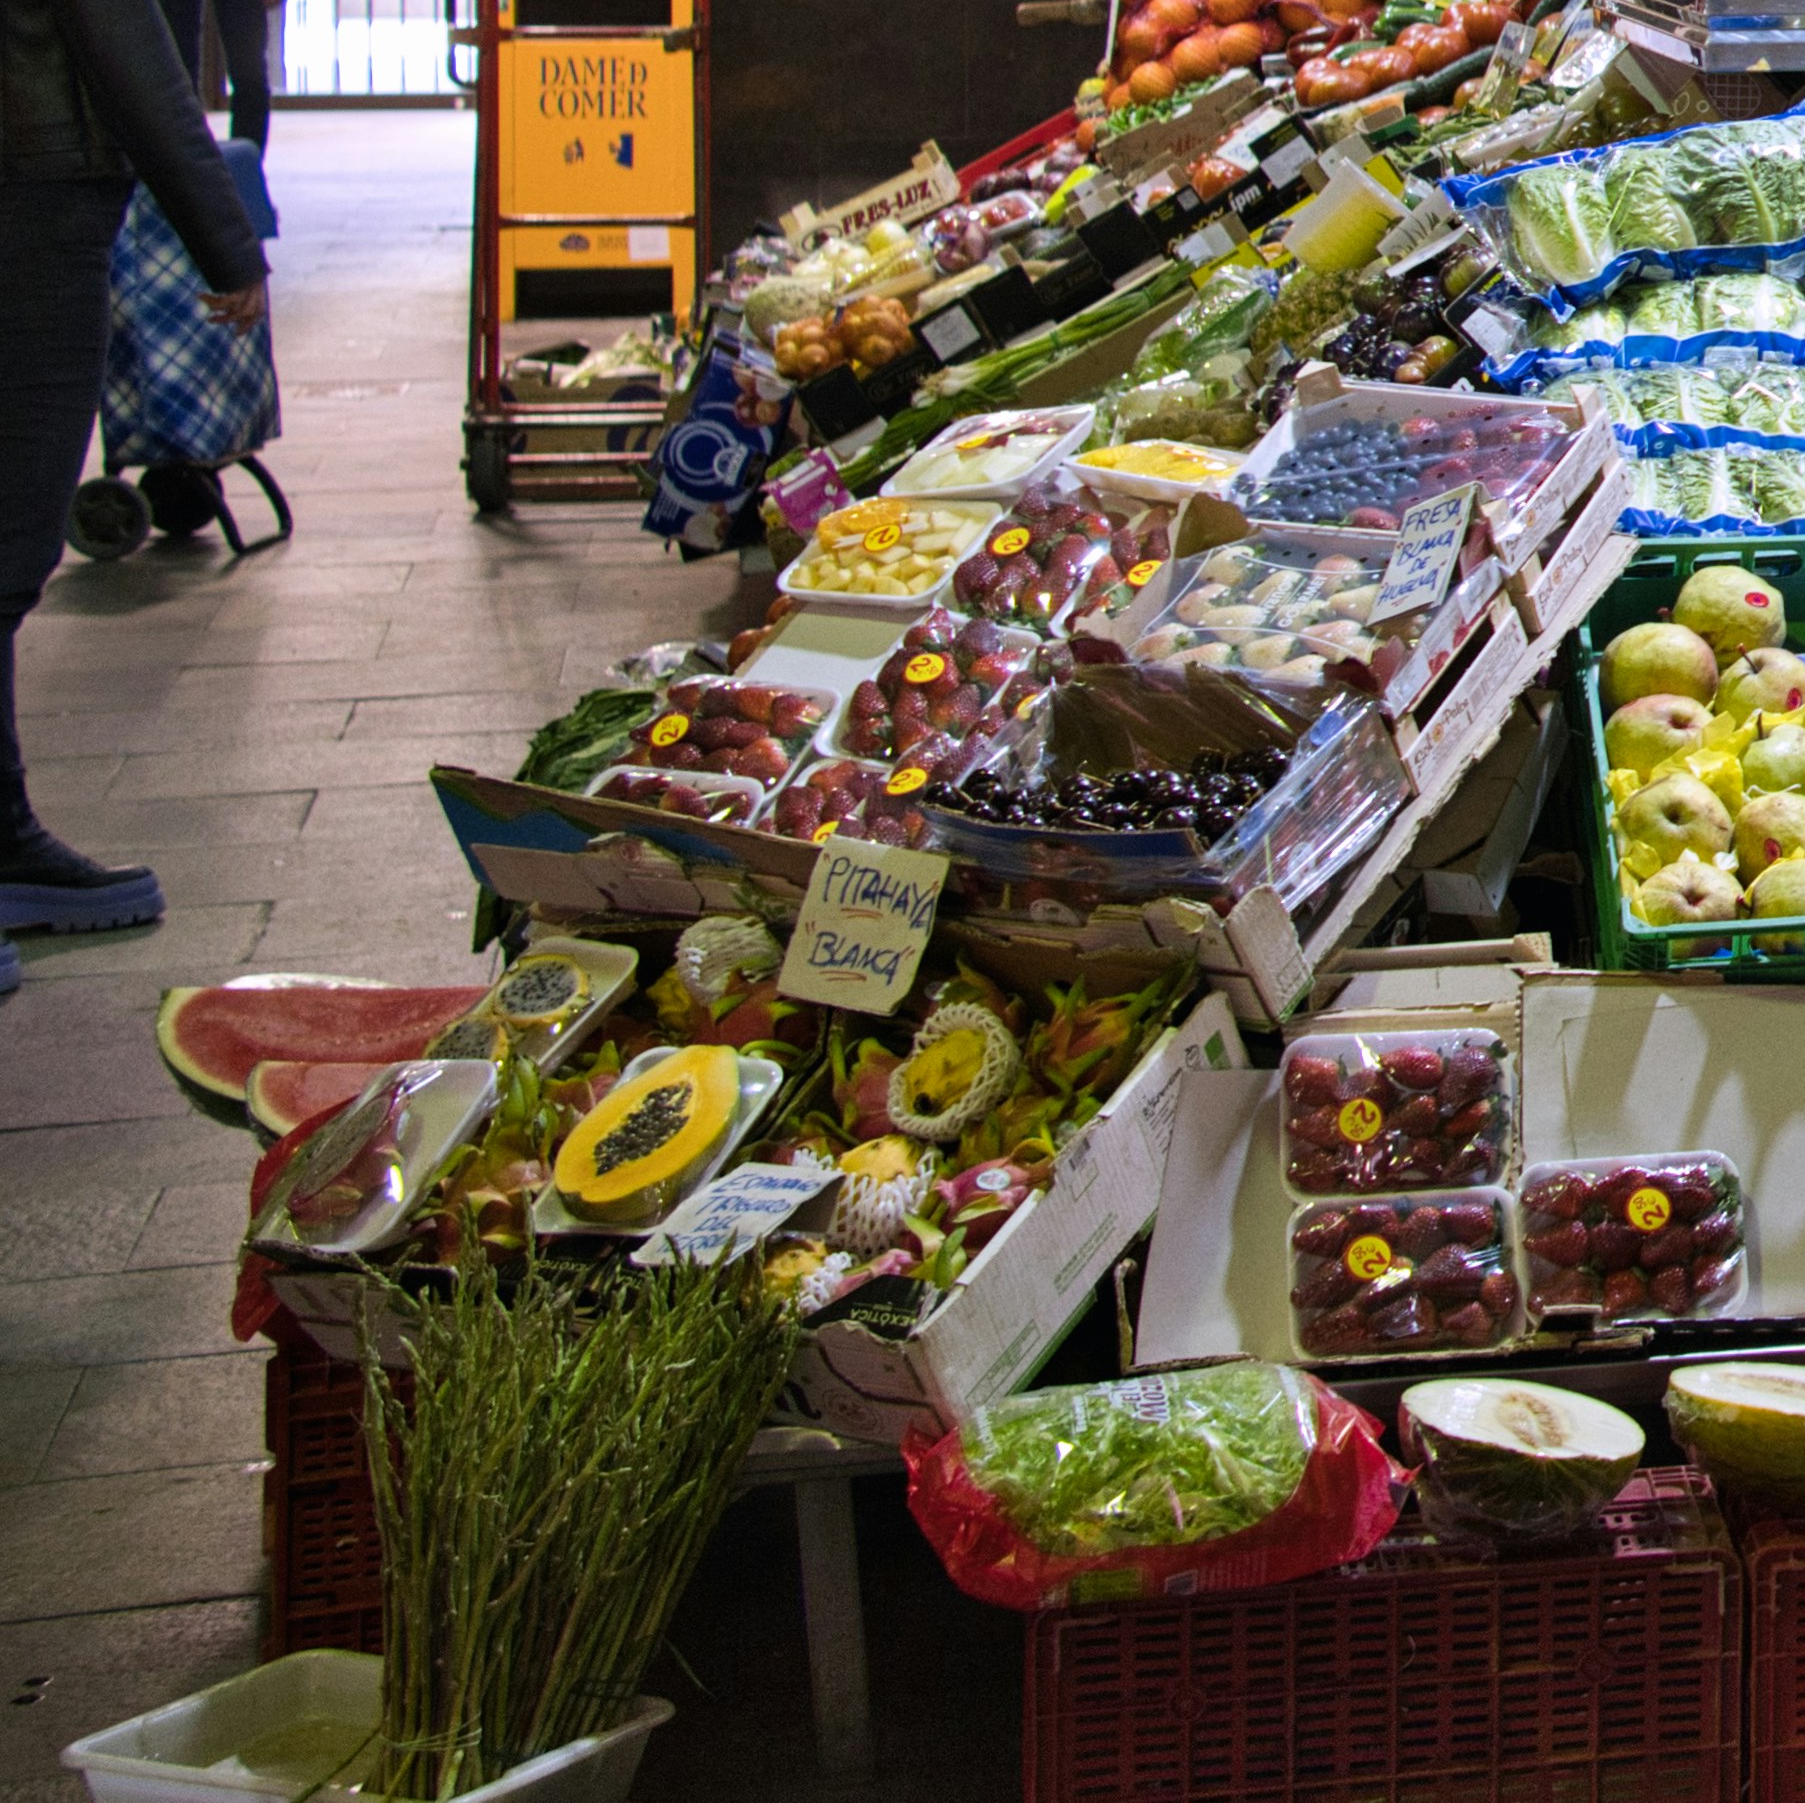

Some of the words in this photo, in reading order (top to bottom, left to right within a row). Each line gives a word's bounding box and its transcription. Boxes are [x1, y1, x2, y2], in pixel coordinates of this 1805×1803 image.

[538, 88, 648, 120] COMER
[1404, 497, 1462, 533] FRESA
[1408, 556, 1428, 576] DE
